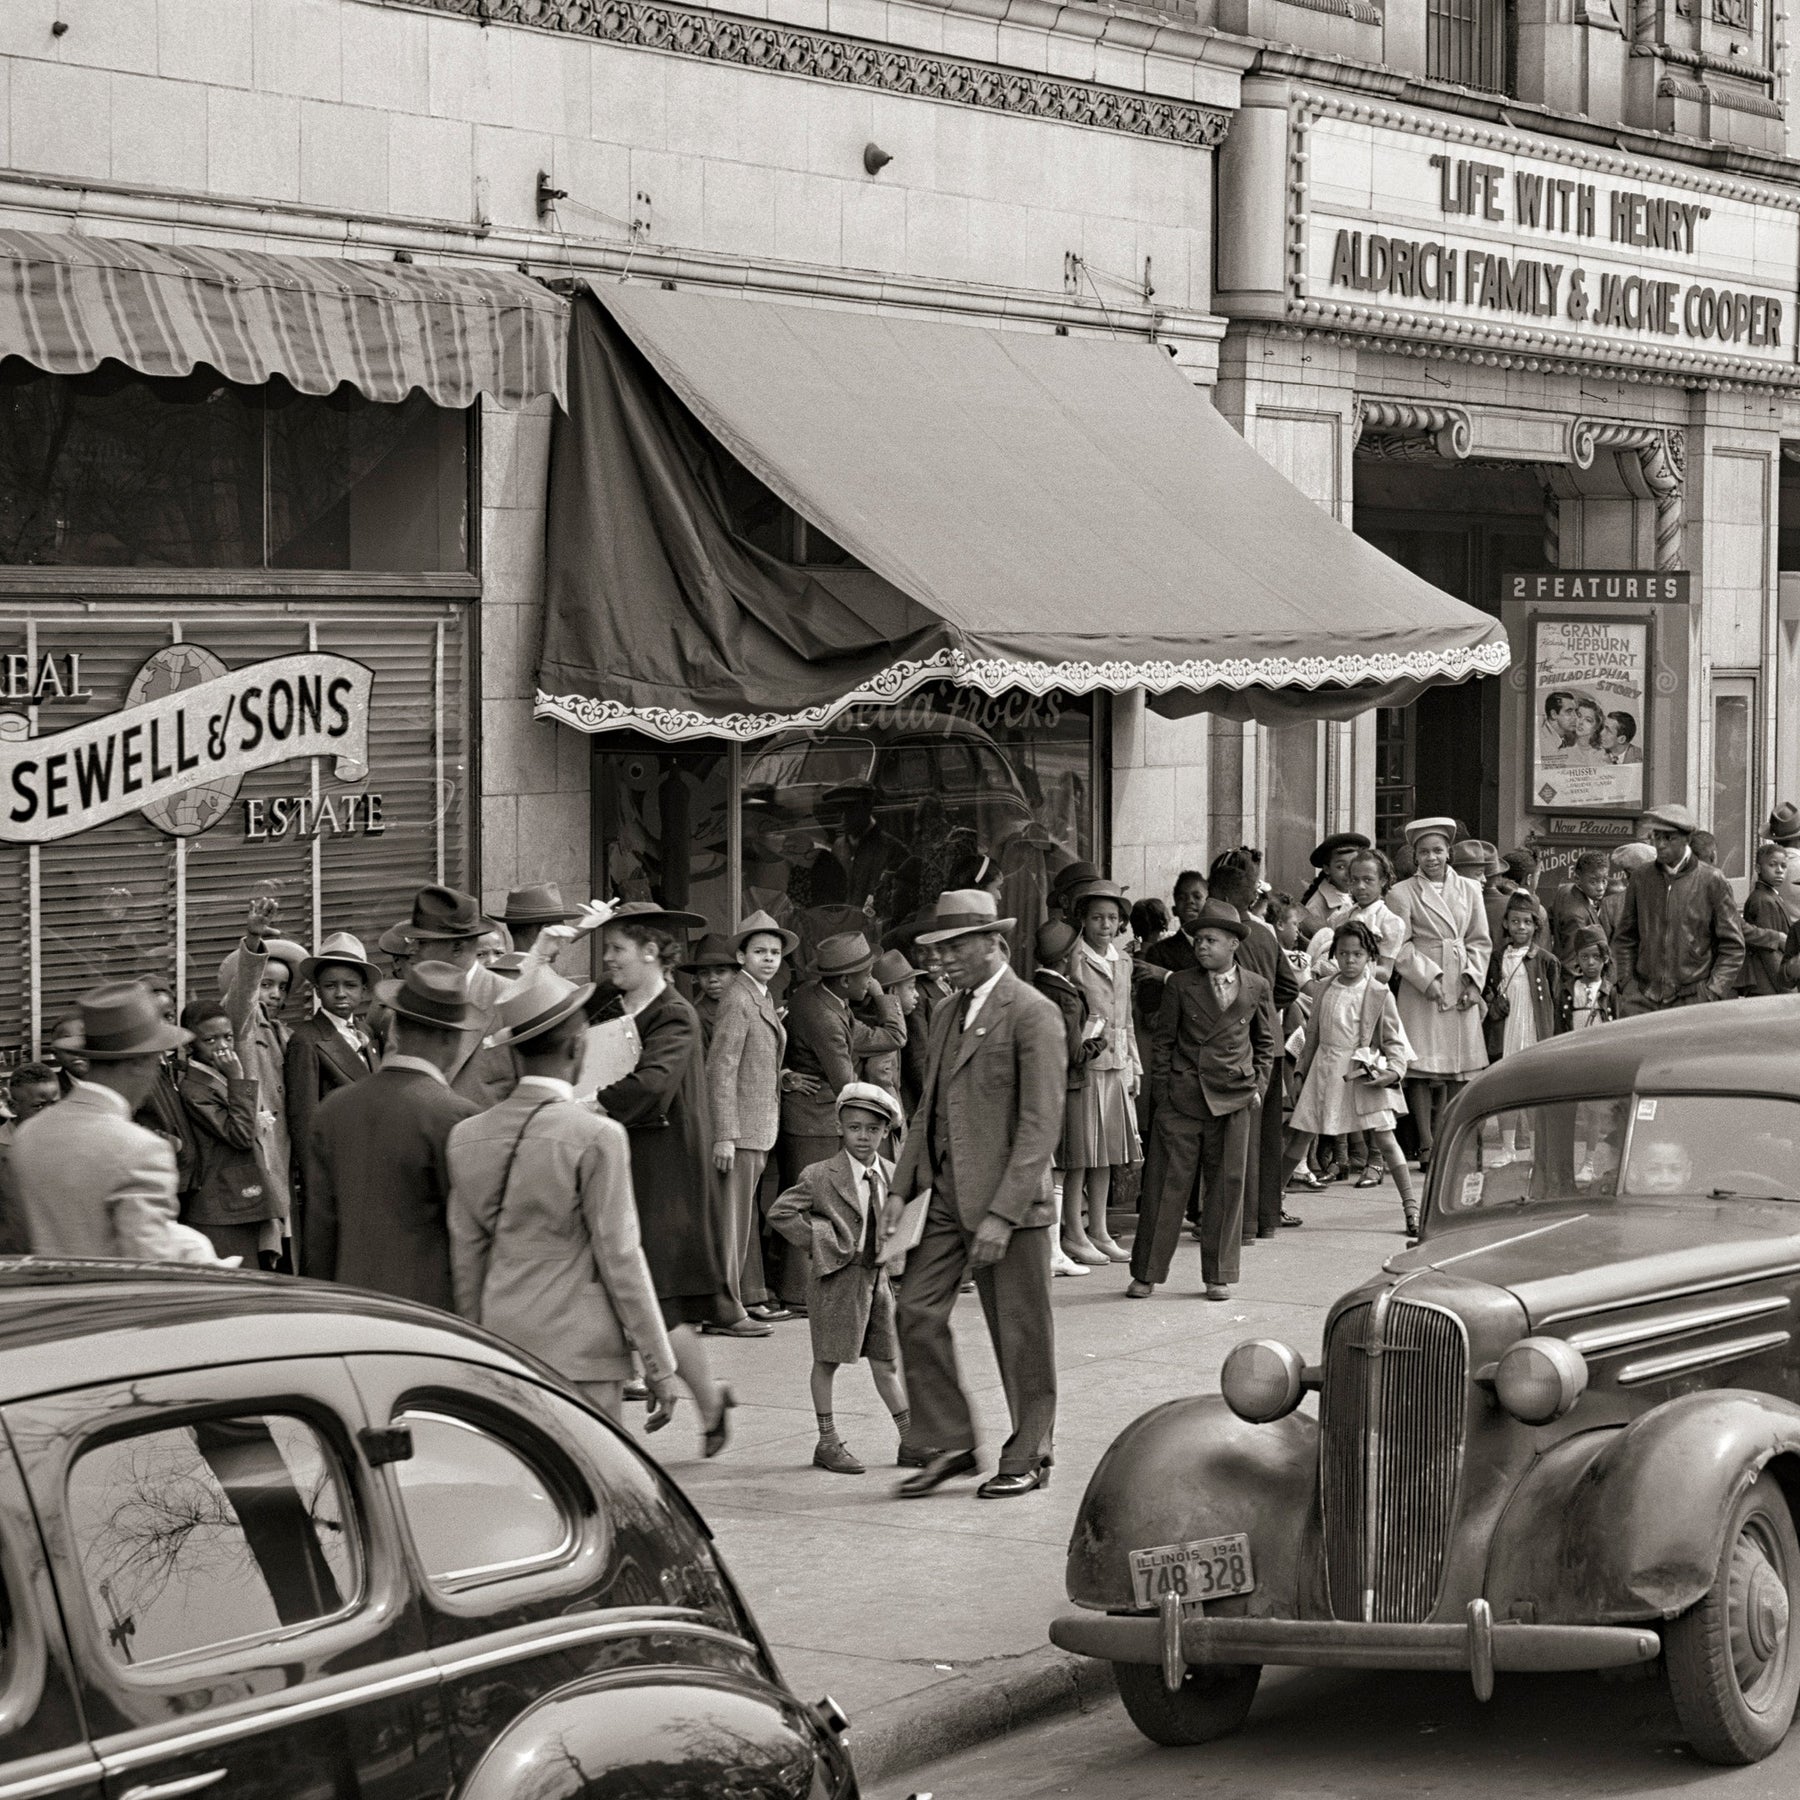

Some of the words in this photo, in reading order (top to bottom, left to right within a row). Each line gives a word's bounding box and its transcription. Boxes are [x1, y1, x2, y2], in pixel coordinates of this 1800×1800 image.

[1515, 170, 1596, 238] WITH
[1331, 228, 1458, 301] ALDRICH
[1465, 248, 1564, 317] FAMILY
[1567, 267, 1590, 321] &
[1593, 271, 1680, 335] JACKIE
[1684, 283, 1783, 347] COOPER
[1513, 577, 1526, 597] 2
[1537, 577, 1678, 599] FEATURES
[1561, 623, 1610, 638] GRANT
[1567, 637, 1630, 652] HEPBURN
[1573, 652, 1637, 667] STEWART
[0, 652, 93, 698] EAL
[1539, 667, 1630, 686] PHILADELPHIA
[1596, 680, 1642, 700] STORY
[9, 708, 200, 824] SEWELL
[238, 674, 354, 751] SONS
[246, 794, 386, 840] ESTATE
[1554, 820, 1576, 833] Now
[1539, 847, 1555, 859] THE
[1136, 1549, 1200, 1568] ILLINOIS
[1212, 1542, 1242, 1556] 1941
[1138, 1563, 1188, 1604] 748
[1198, 1553, 1247, 1593] 328
